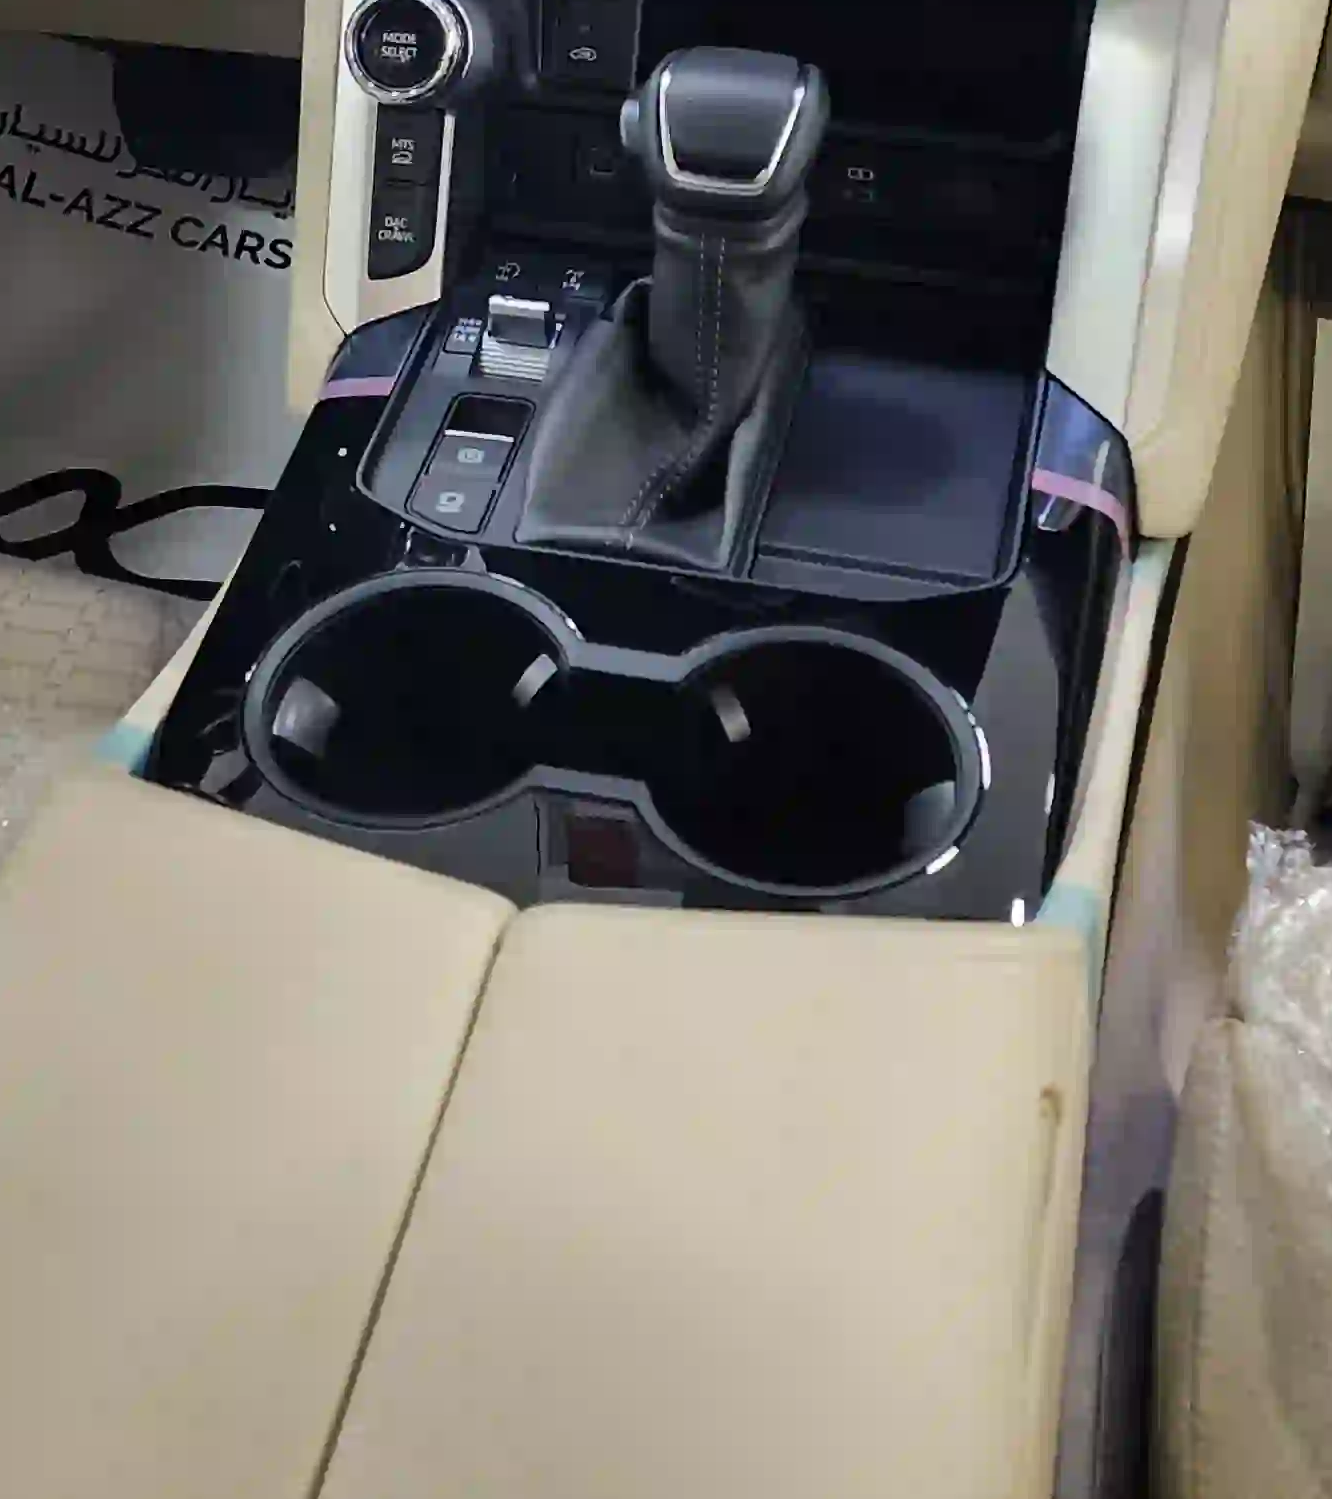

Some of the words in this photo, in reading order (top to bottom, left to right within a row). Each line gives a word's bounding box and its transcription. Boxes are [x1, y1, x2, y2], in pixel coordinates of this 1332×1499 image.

[382, 31, 418, 45] MODE
[380, 45, 418, 63] SELECT
[169, 215, 295, 270] CARS
